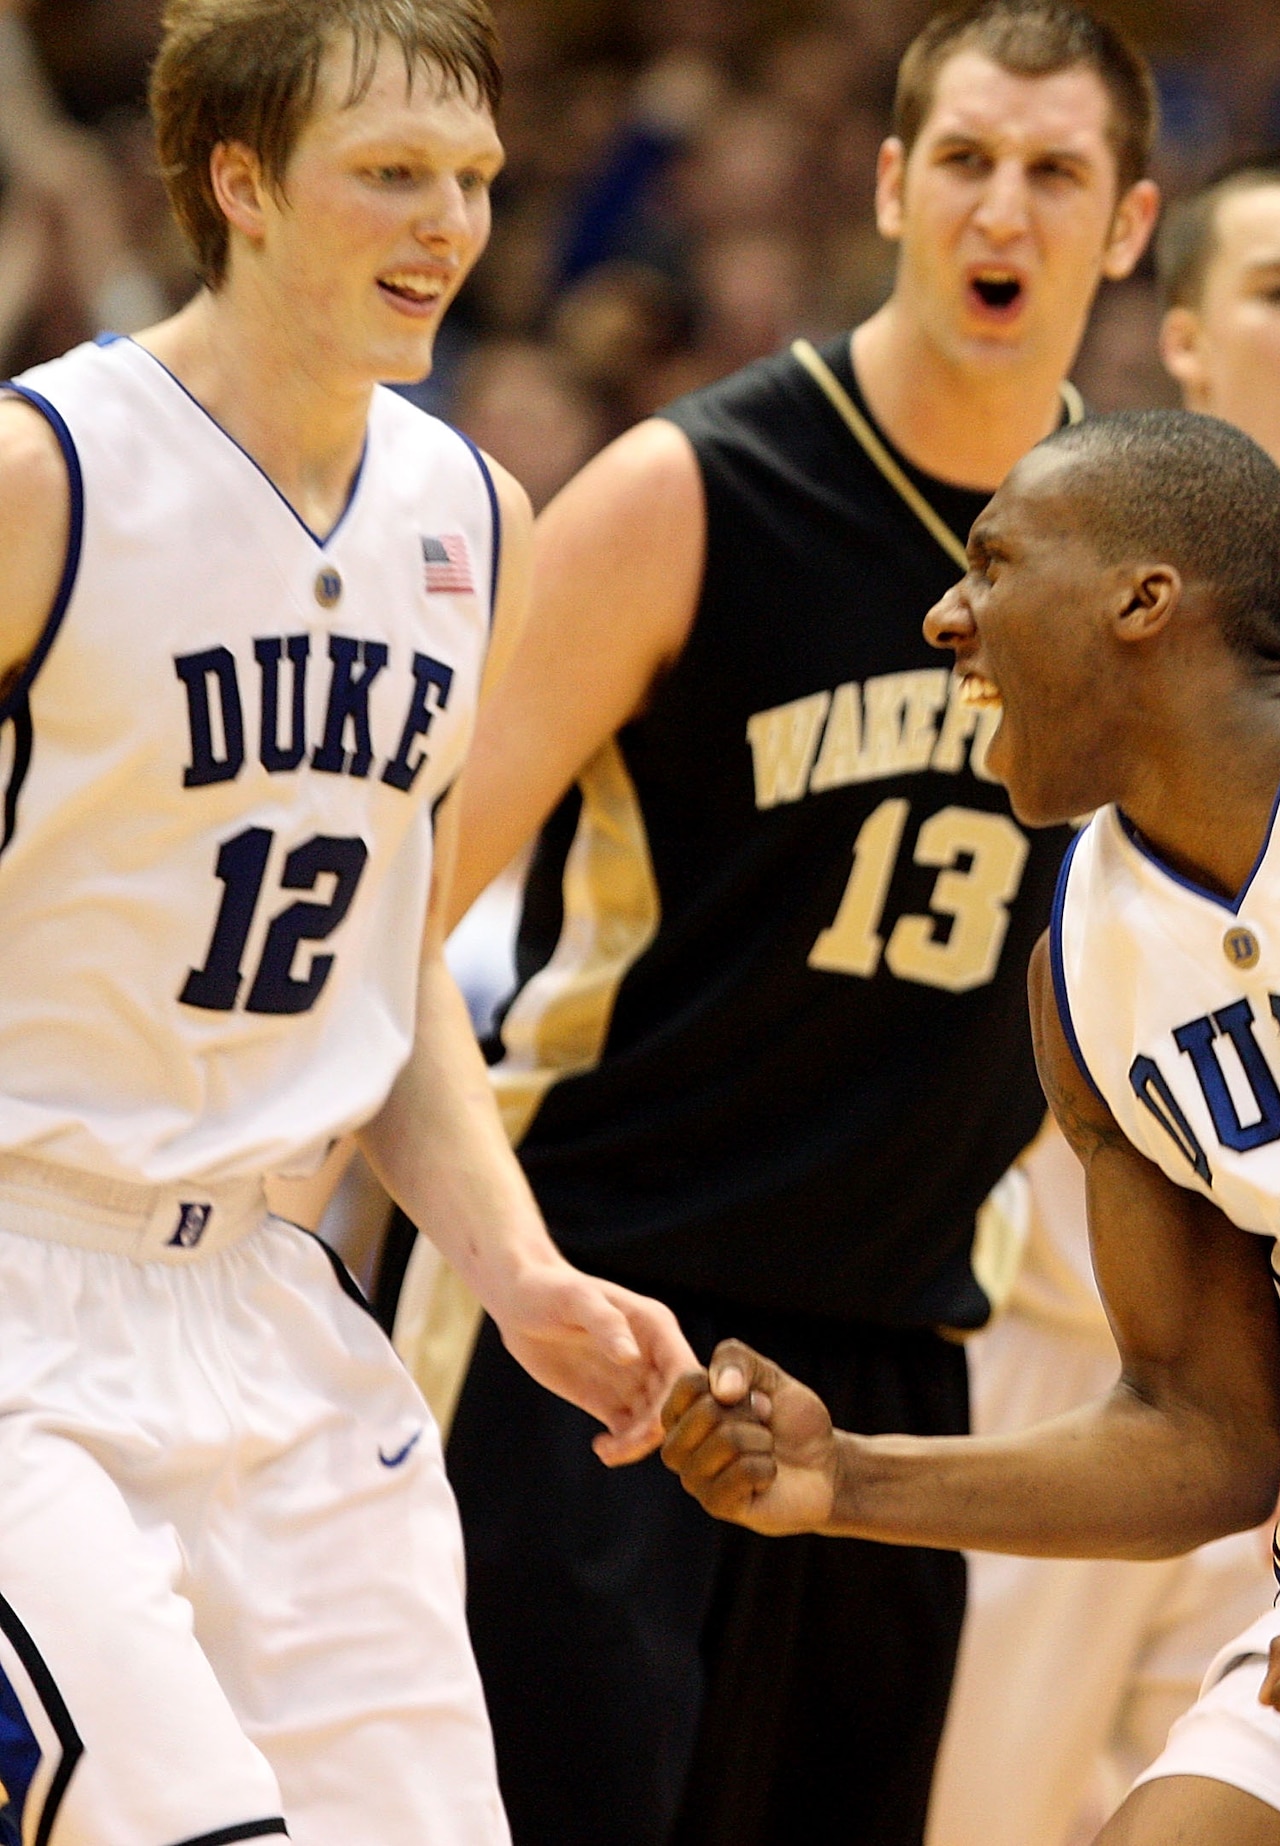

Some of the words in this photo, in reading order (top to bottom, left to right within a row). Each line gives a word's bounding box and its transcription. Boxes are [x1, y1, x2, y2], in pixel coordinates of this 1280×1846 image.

[174, 632, 455, 792] DUKE
[177, 826, 369, 1015] 12
[806, 797, 1031, 994] 13
